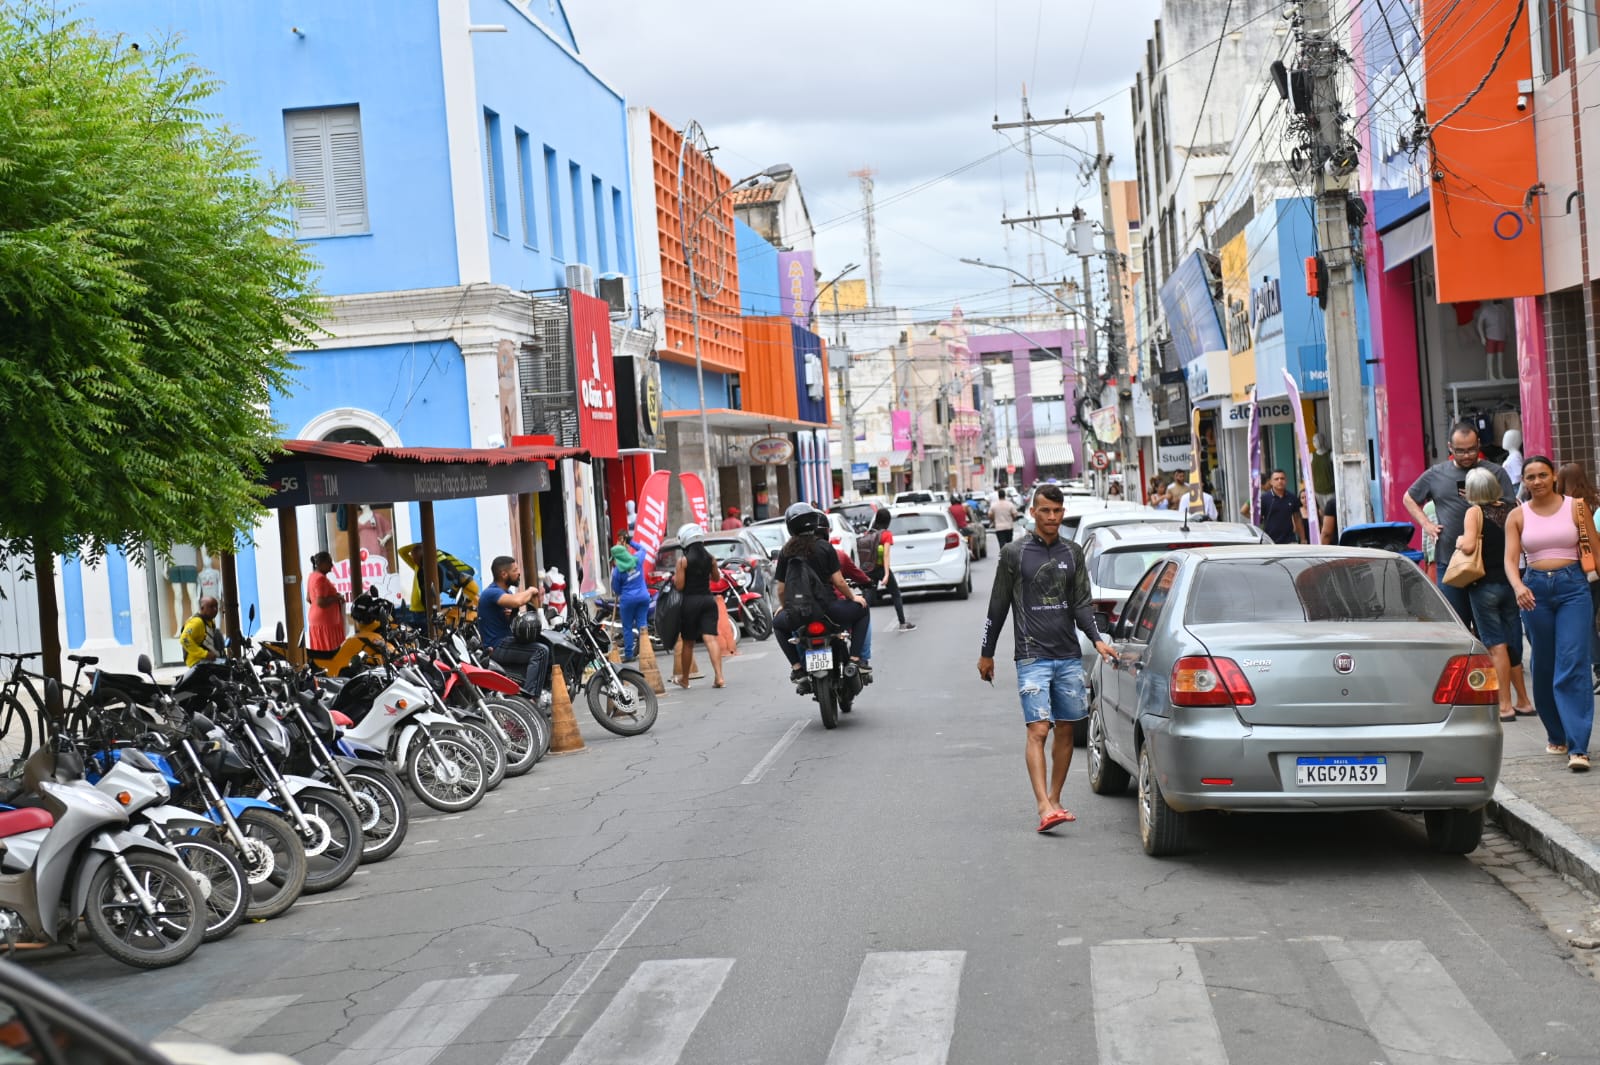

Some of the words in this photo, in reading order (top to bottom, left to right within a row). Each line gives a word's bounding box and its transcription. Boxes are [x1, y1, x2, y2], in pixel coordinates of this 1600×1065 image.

[1230, 403, 1290, 419] alcnce
[280, 477, 298, 493] 5G
[323, 475, 338, 496] TIM
[1242, 658, 1272, 667] Siena
[1307, 765, 1378, 782] KGC9A39
